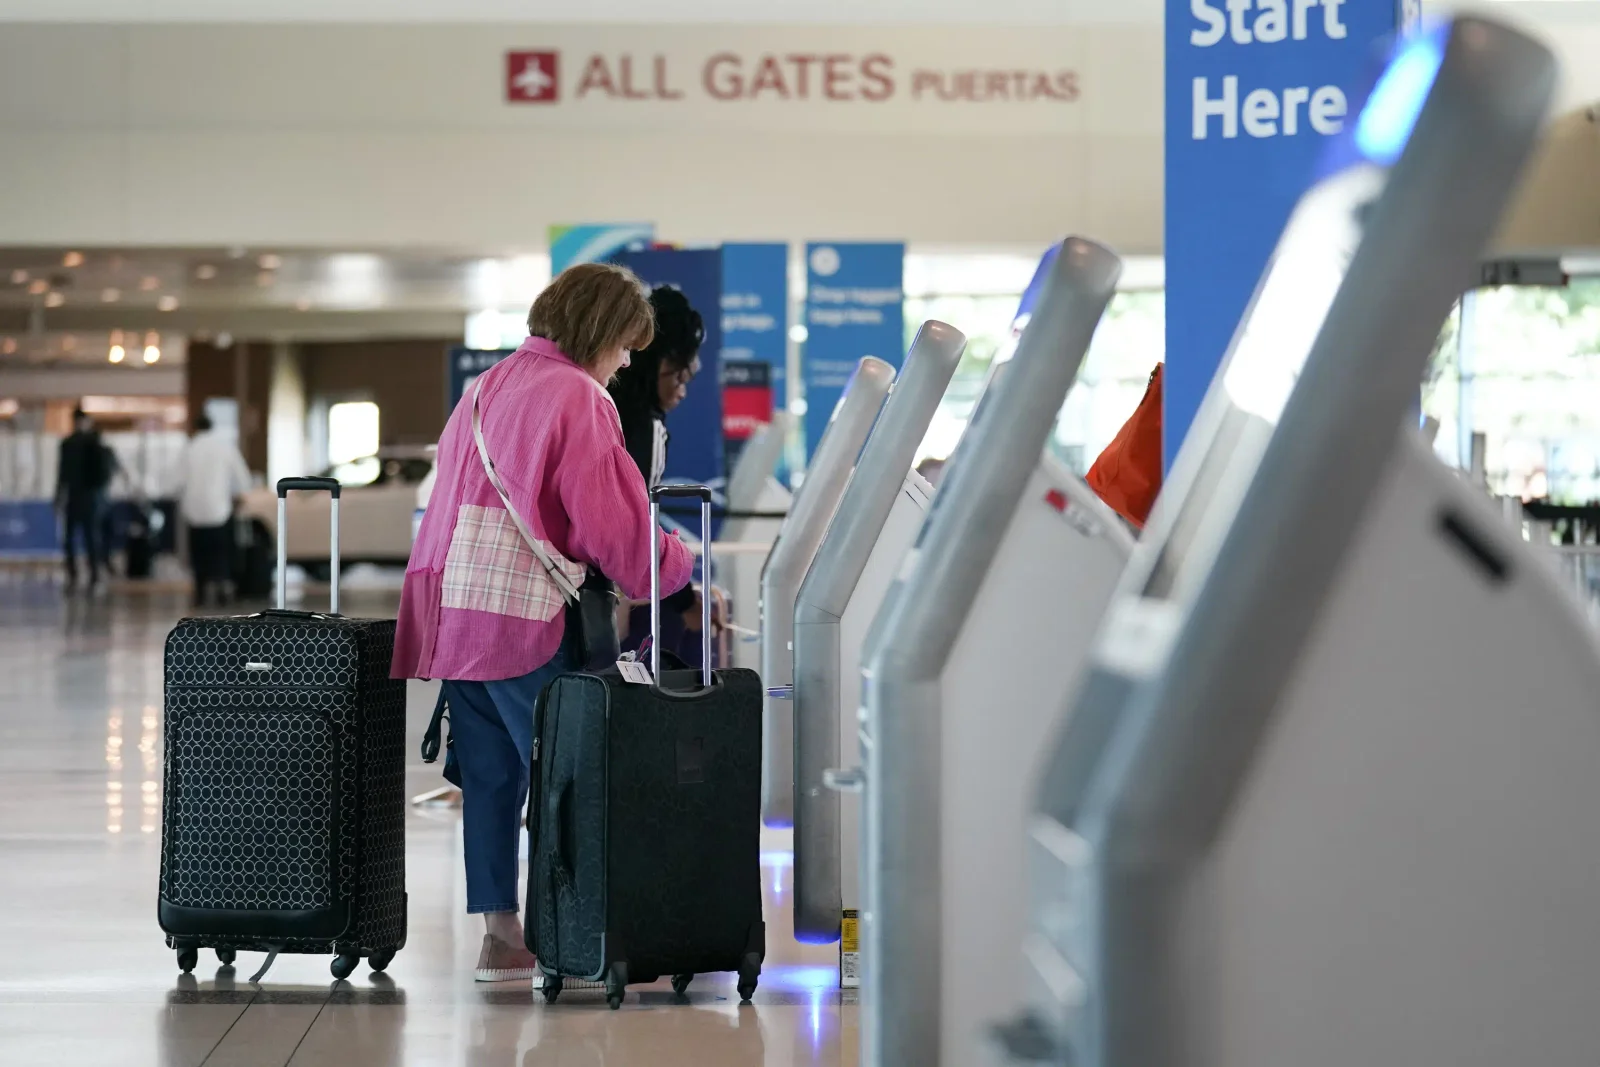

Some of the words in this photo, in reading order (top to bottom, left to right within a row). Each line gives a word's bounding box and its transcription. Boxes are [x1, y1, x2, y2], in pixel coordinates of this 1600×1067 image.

[1190, 0, 1347, 47] Start
[574, 53, 683, 100] ALL
[702, 52, 896, 101] GATES
[911, 69, 1080, 101] PUERTAS
[1192, 75, 1348, 139] Here
